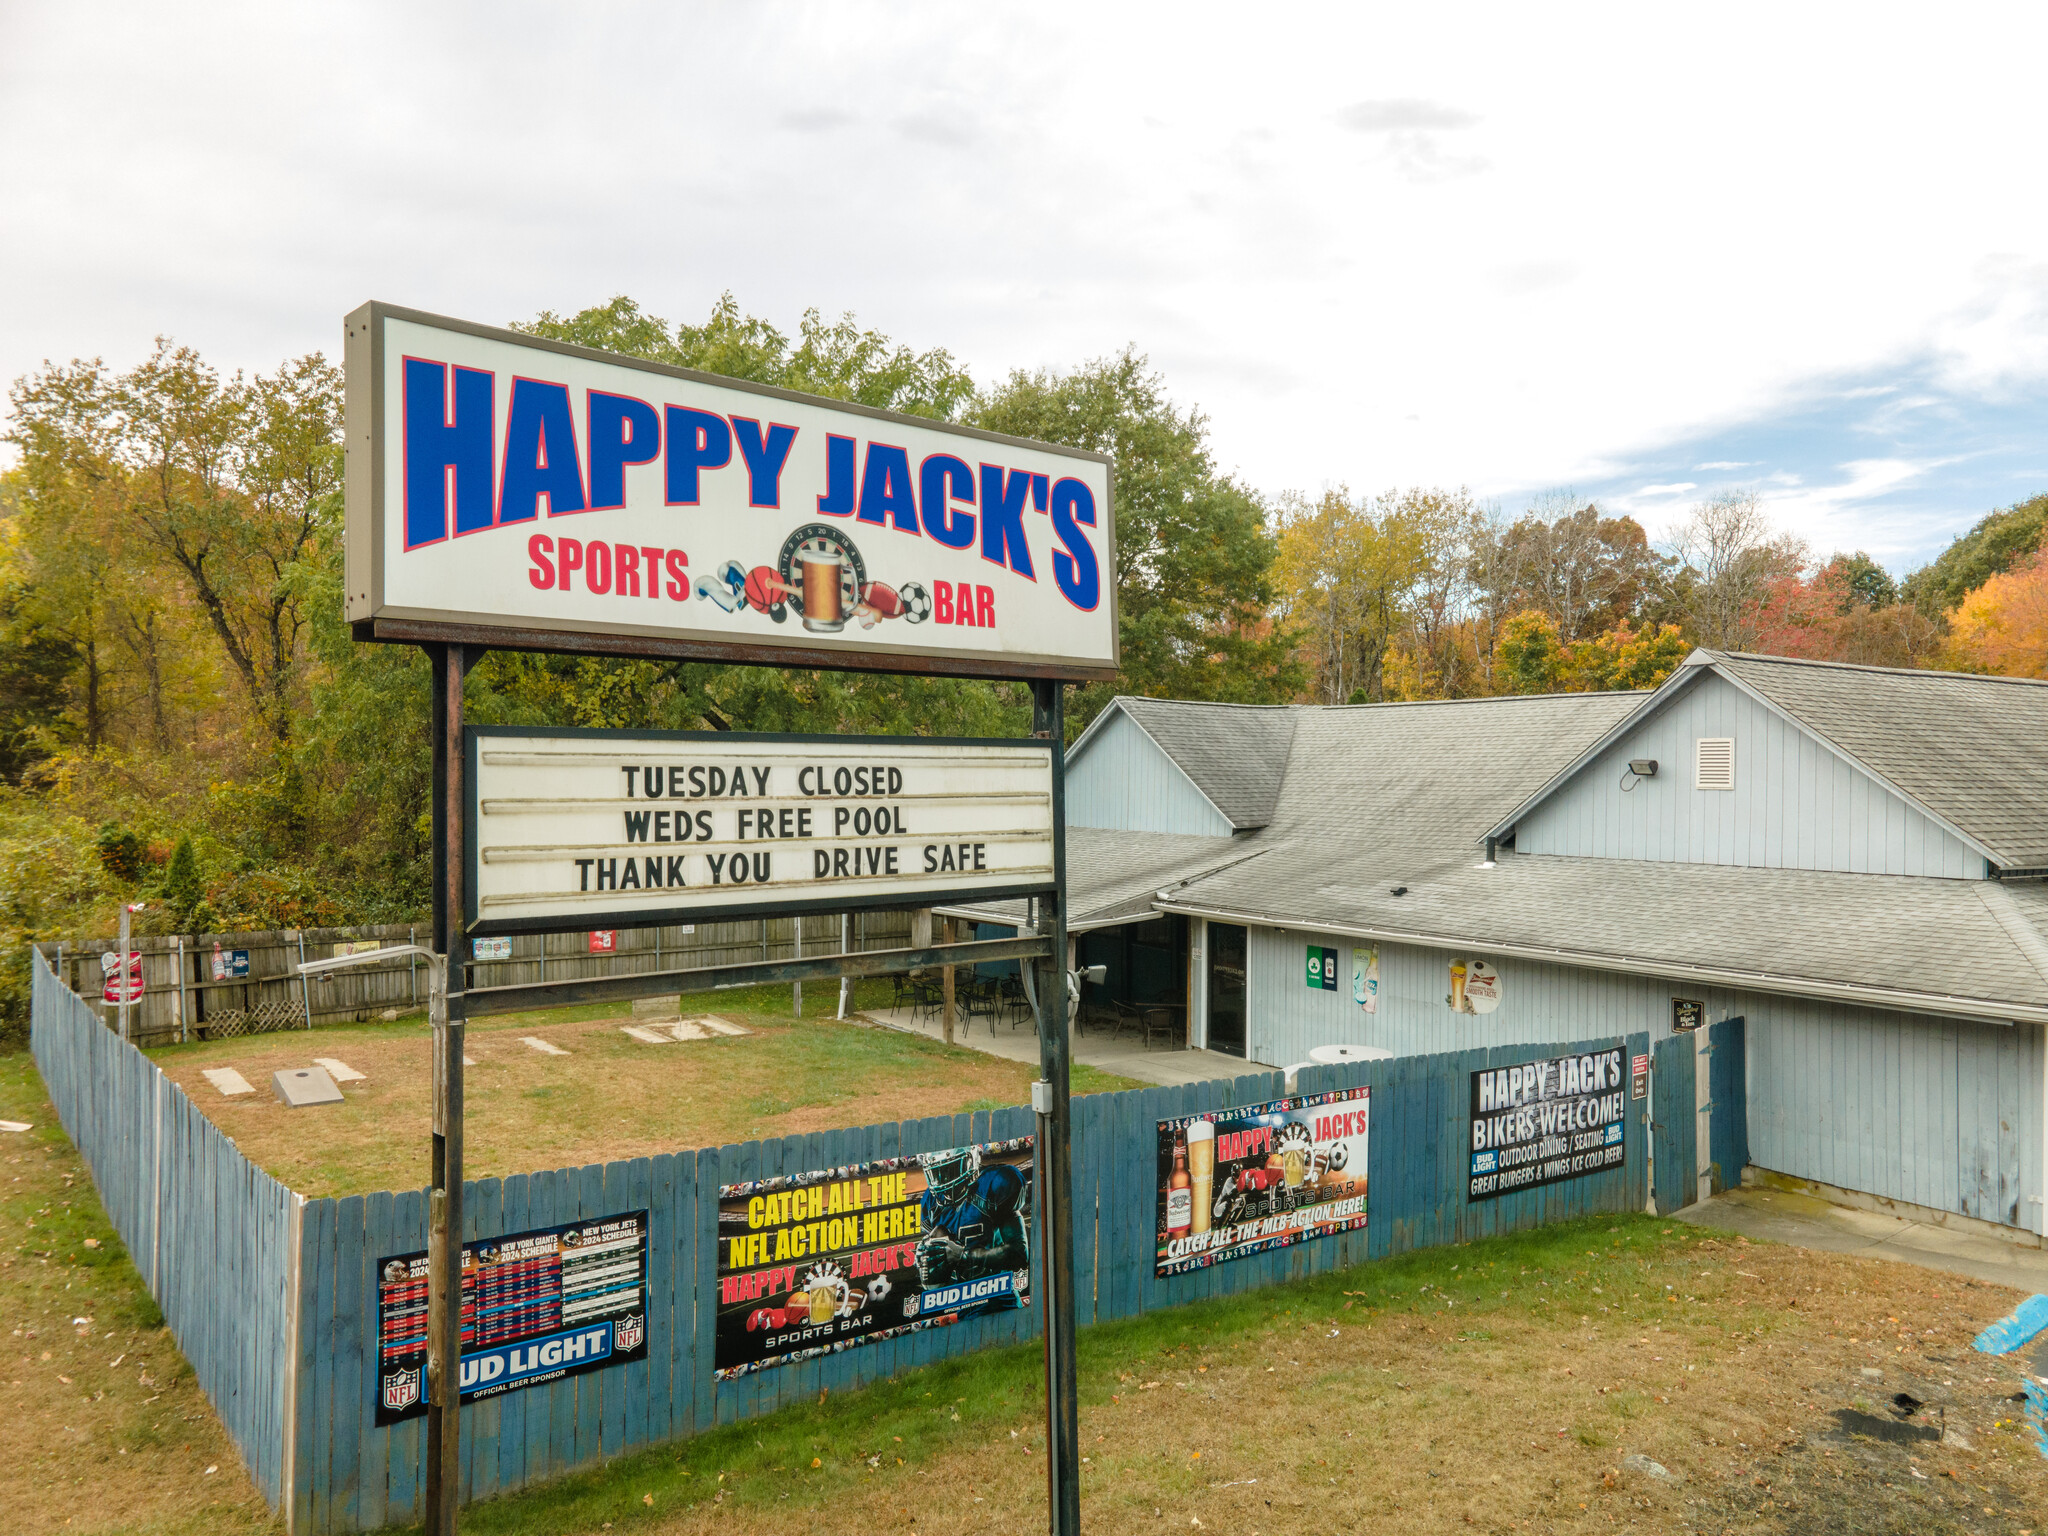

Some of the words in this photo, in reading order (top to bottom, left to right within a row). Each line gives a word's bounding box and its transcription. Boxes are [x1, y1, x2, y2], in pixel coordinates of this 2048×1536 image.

[402, 354, 800, 552] HAPPY
[816, 432, 1100, 612] JACK'S
[527, 534, 690, 601] SPORTS
[932, 579, 996, 629] BAR
[621, 766, 771, 798] TUESDAY
[798, 766, 903, 796] CLOSED
[625, 810, 713, 842] WEDS
[737, 808, 812, 840] FREE
[834, 806, 907, 836] POOL
[575, 856, 687, 892] THANK
[706, 852, 771, 885] YOU
[815, 847, 899, 879] DRIVE
[924, 843, 986, 873] SAFE
[1466, 987, 1483, 995] SMOOTH
[1484, 990, 1497, 998] TASTE
[1479, 1062, 1549, 1112] HAPPY
[1558, 1050, 1621, 1097] JACK'S
[1314, 1110, 1366, 1142] JACK'S
[1473, 1109, 1535, 1151] BIKERS
[1540, 1091, 1624, 1136] WELCOME!
[1608, 1124, 1620, 1135] BUD
[1218, 1125, 1273, 1162] HAPPY
[1499, 1143, 1538, 1168] OUTDOOR
[1539, 1137, 1567, 1158] DINING
[1574, 1130, 1604, 1151] SEATING
[1605, 1132, 1622, 1144] LIGHT
[1471, 1175, 1497, 1195] GREAT
[1499, 1166, 1534, 1188] BURGERS
[1536, 1168, 1542, 1180] &
[1544, 1158, 1570, 1179] WINGS
[1572, 1156, 1583, 1173] ICE
[1584, 1150, 1603, 1169] COLD
[1604, 1145, 1623, 1164] BEER!
[1473, 1161, 1496, 1173] LIGHT
[1476, 1153, 1493, 1164] BUD
[748, 1186, 823, 1229] CATCH
[828, 1178, 864, 1215] ALL
[868, 1172, 907, 1204] THE
[1245, 1190, 1315, 1218] SPORTS
[1323, 1181, 1356, 1200] BAR
[583, 1226, 599, 1237] NEW
[600, 1222, 620, 1233] YORK
[621, 1219, 637, 1230] JETS
[583, 1236, 601, 1246] 2024
[602, 1227, 637, 1242] SCHEDULE
[729, 1231, 770, 1269] NFL
[775, 1217, 859, 1260] ACTION
[863, 1204, 921, 1243] HERE!
[1167, 1234, 1209, 1258] CATCH
[1210, 1228, 1232, 1247] ALL
[1236, 1221, 1261, 1242] THE
[1261, 1213, 1287, 1235] MLB
[1288, 1205, 1330, 1230] ACTION
[1333, 1195, 1364, 1218] HERE!
[501, 1243, 516, 1253] NEW
[517, 1239, 534, 1249] YORK
[535, 1234, 558, 1246] GIANTS
[501, 1250, 520, 1262] 2024
[521, 1242, 558, 1258] SCHEDULE
[410, 1259, 422, 1268] NEW
[410, 1266, 429, 1278] 2024
[722, 1265, 797, 1304] HAPPY
[850, 1242, 916, 1278] JACK'S
[924, 1288, 960, 1310] BUD
[962, 1276, 1009, 1301] LIGHT
[1014, 1277, 1028, 1290] NFL
[904, 1304, 918, 1315] NFL
[971, 1299, 988, 1307] SPONSOR
[616, 1331, 642, 1349] NFL
[765, 1324, 833, 1348] SPORTS
[841, 1315, 873, 1330] BAR
[460, 1354, 504, 1387] UD
[509, 1328, 606, 1369] LIGHT
[388, 1383, 415, 1406] NFL
[473, 1384, 508, 1398] OFFICIAL
[509, 1377, 529, 1390] BEER
[530, 1369, 566, 1384] SPONSOR
